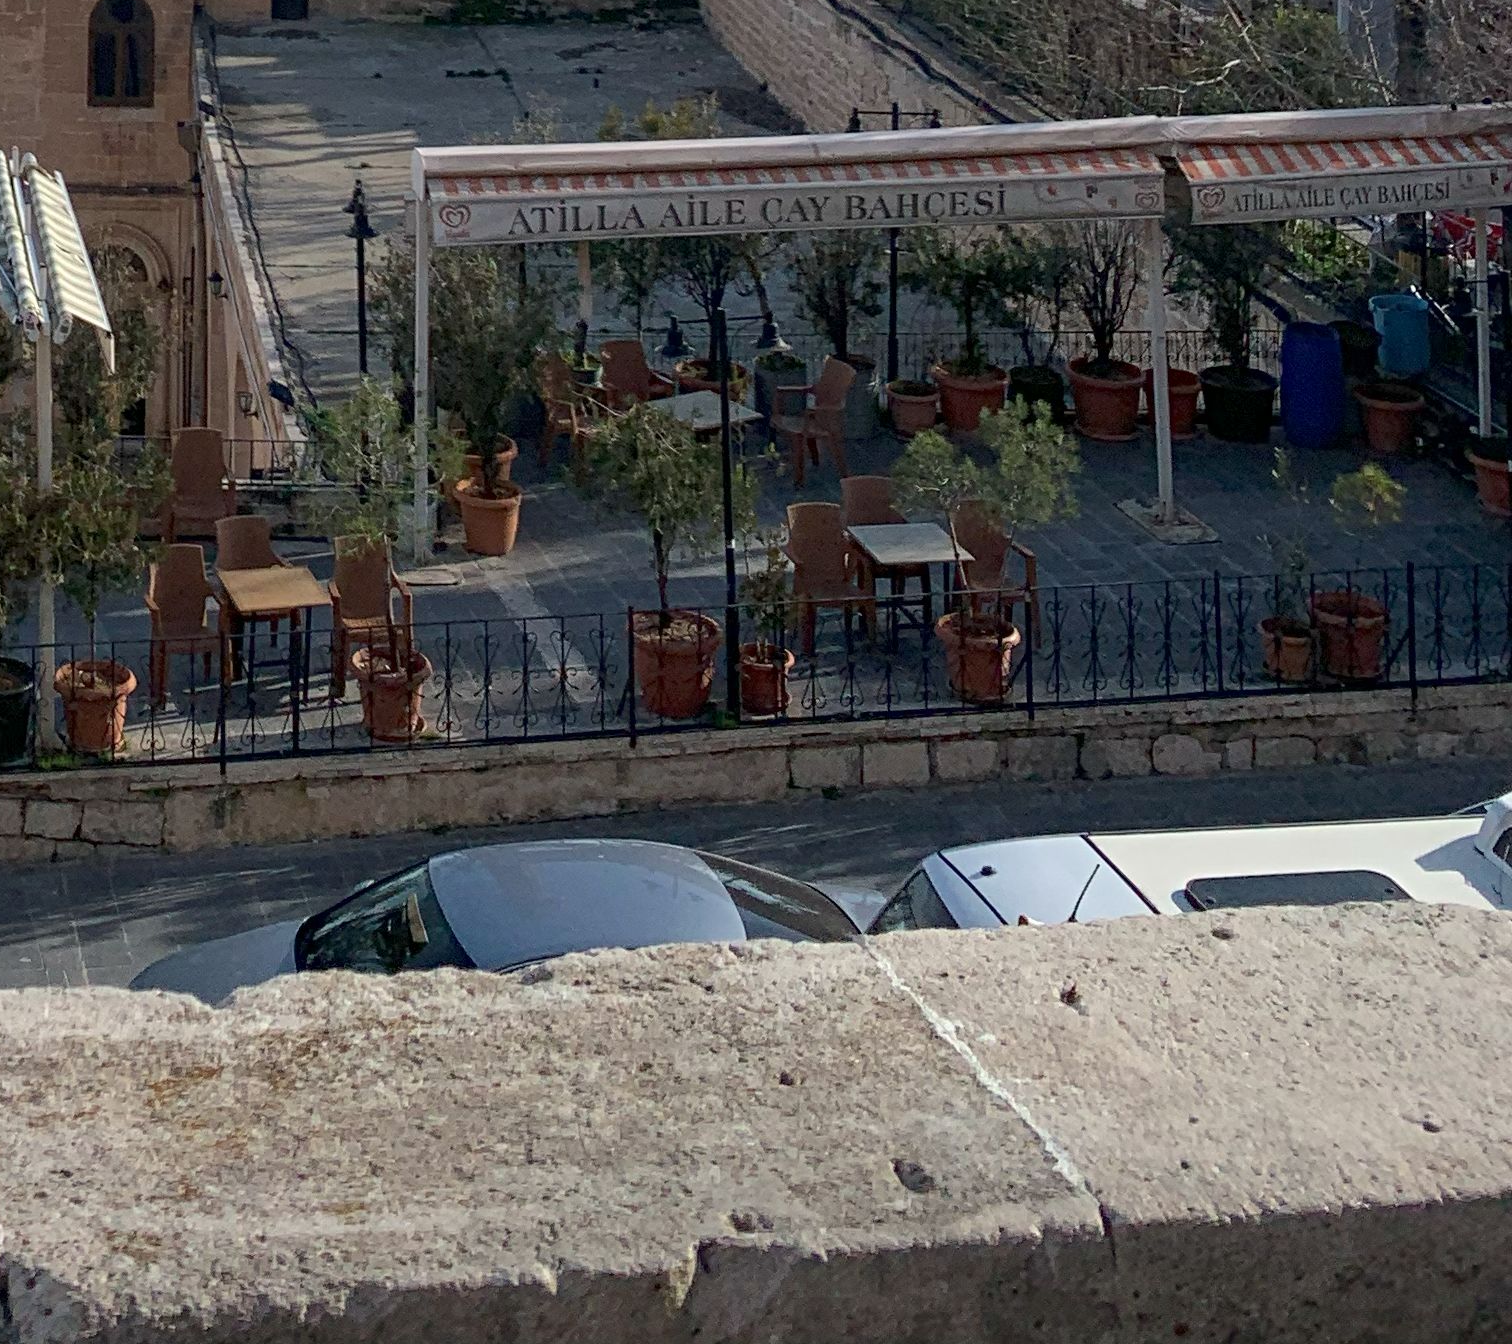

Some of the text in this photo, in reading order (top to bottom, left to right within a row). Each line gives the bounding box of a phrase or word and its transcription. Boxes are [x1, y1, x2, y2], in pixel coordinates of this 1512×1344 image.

[508, 183, 1006, 236] ATİLLA AİLE ÇAY BAHÇESİ
[1296, 188, 1334, 208] AİLE
[1340, 185, 1372, 211] ÇAY
[1377, 177, 1450, 205] BAHÇESİ
